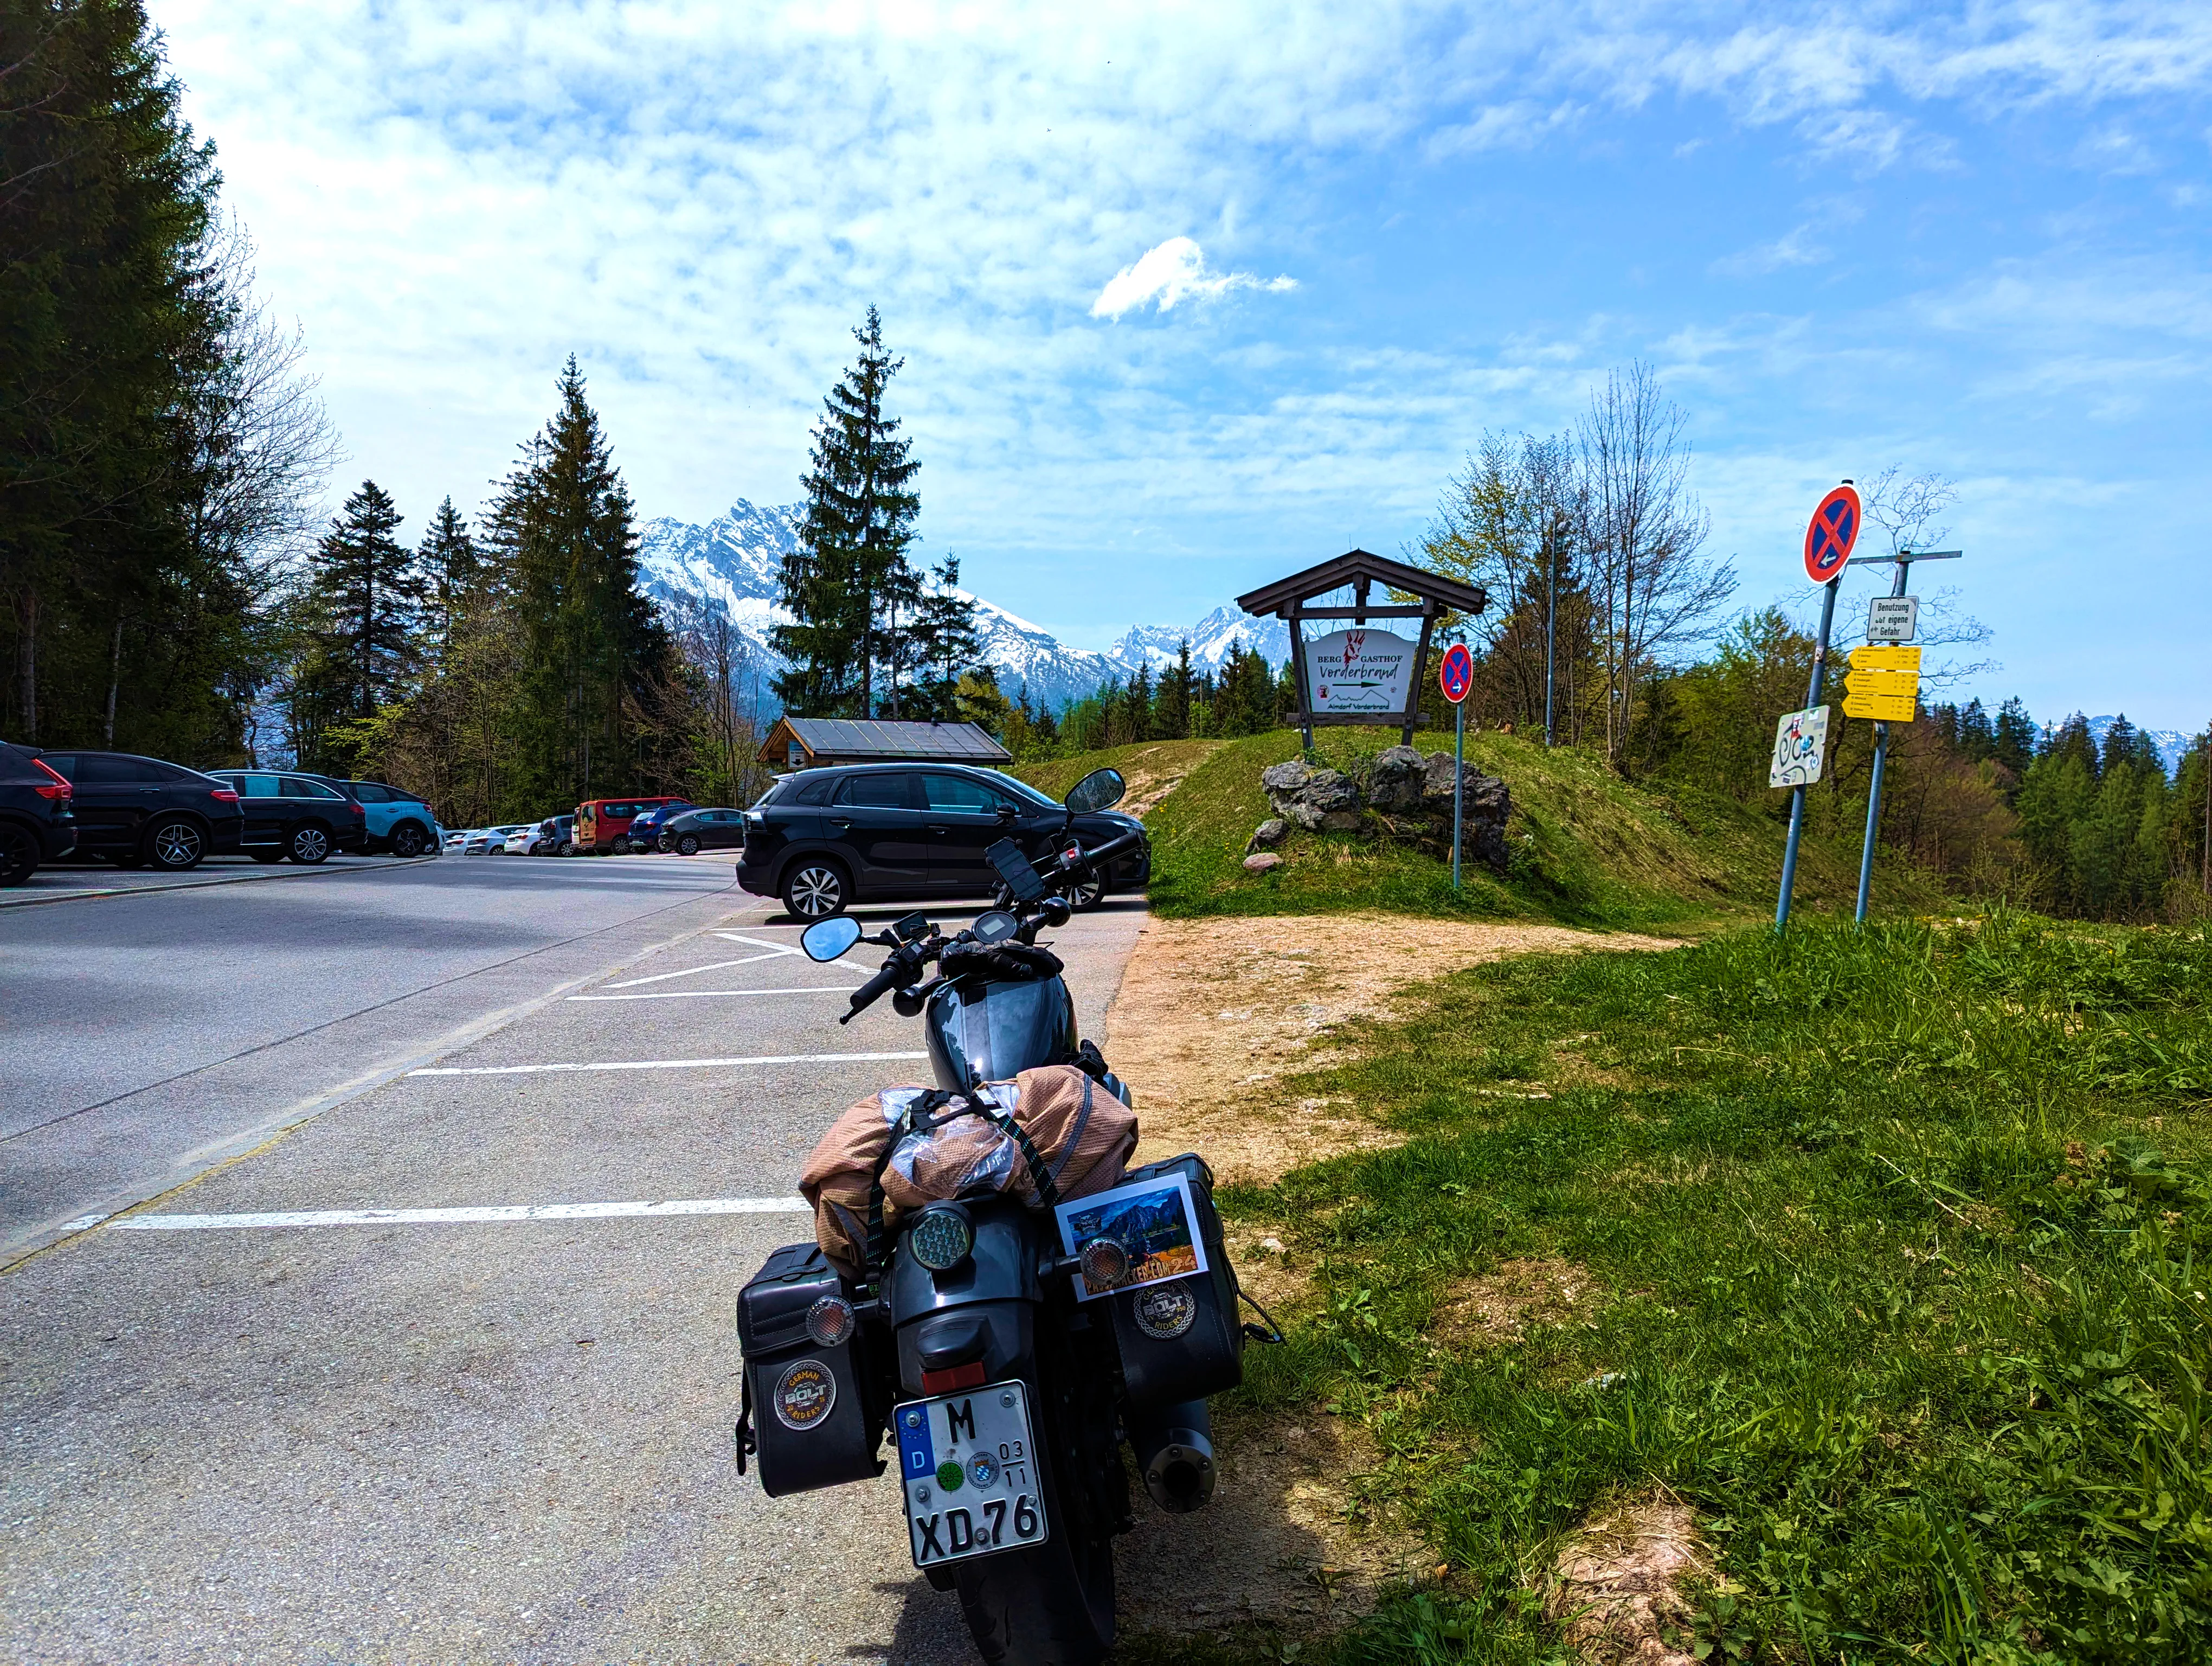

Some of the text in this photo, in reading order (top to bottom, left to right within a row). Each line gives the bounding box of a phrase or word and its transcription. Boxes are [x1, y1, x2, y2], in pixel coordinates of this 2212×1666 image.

[1877, 603, 1909, 613] Benutzung
[1888, 614, 1908, 625] eigene
[1880, 627, 1901, 636] Gefahr
[1320, 663, 1399, 680] Vorderbrand
[1143, 1283, 1176, 1300] GERMAN
[1143, 1295, 1183, 1316] BOLT
[1154, 1315, 1183, 1330] RIDERS
[789, 1370, 820, 1386] GERMAN
[785, 1384, 827, 1405] BOLT
[792, 1406, 820, 1419] RIDERS
[947, 1398, 976, 1444] M
[911, 1439, 1024, 1469] D 03
[1005, 1467, 1026, 1488] 11
